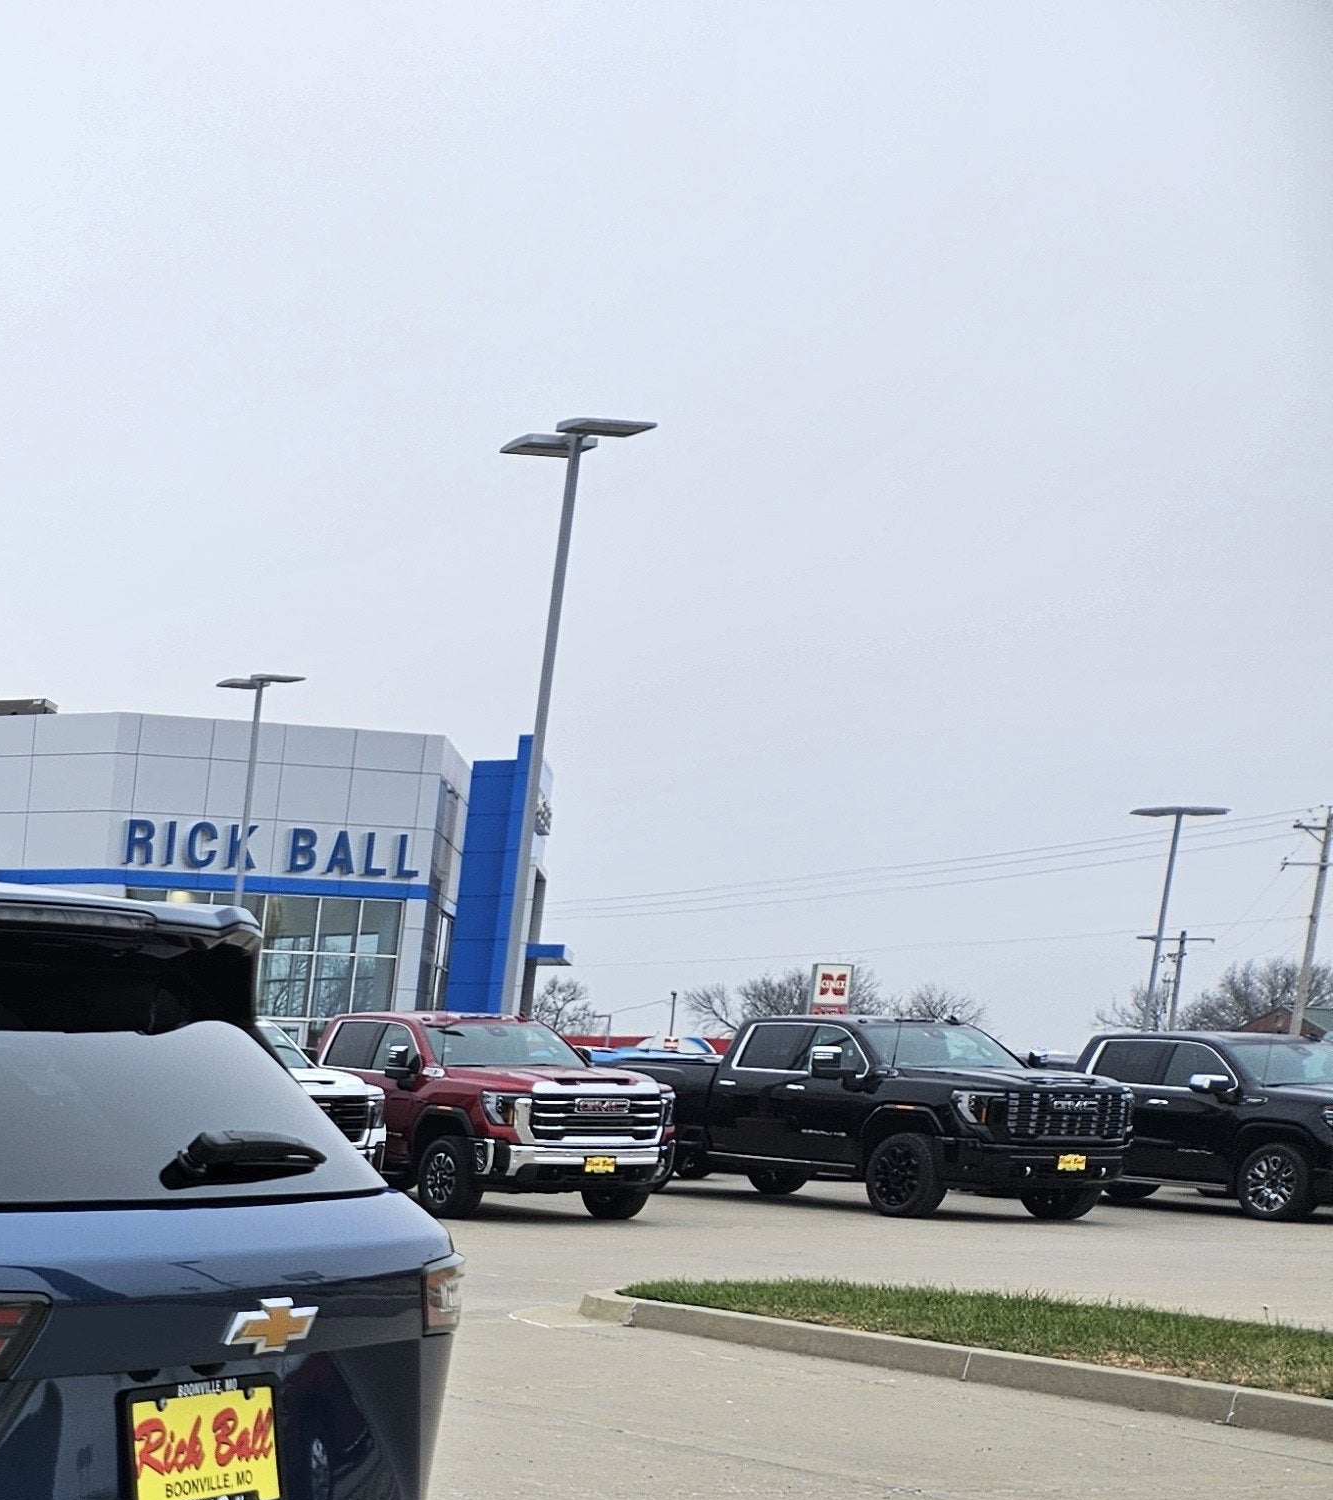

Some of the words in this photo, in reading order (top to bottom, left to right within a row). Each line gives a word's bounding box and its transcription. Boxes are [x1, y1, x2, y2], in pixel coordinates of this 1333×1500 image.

[122, 818, 260, 869] RICK
[287, 827, 420, 878] BALL
[579, 1100, 628, 1111] GMC
[1053, 1100, 1099, 1111] GMC
[177, 1380, 222, 1398] BOONVILLE,
[224, 1377, 238, 1391] MO
[134, 1414, 206, 1479] Rick
[212, 1406, 274, 1467] Ball
[165, 1476, 231, 1499] BOONVILLE,
[236, 1469, 253, 1487] MO
